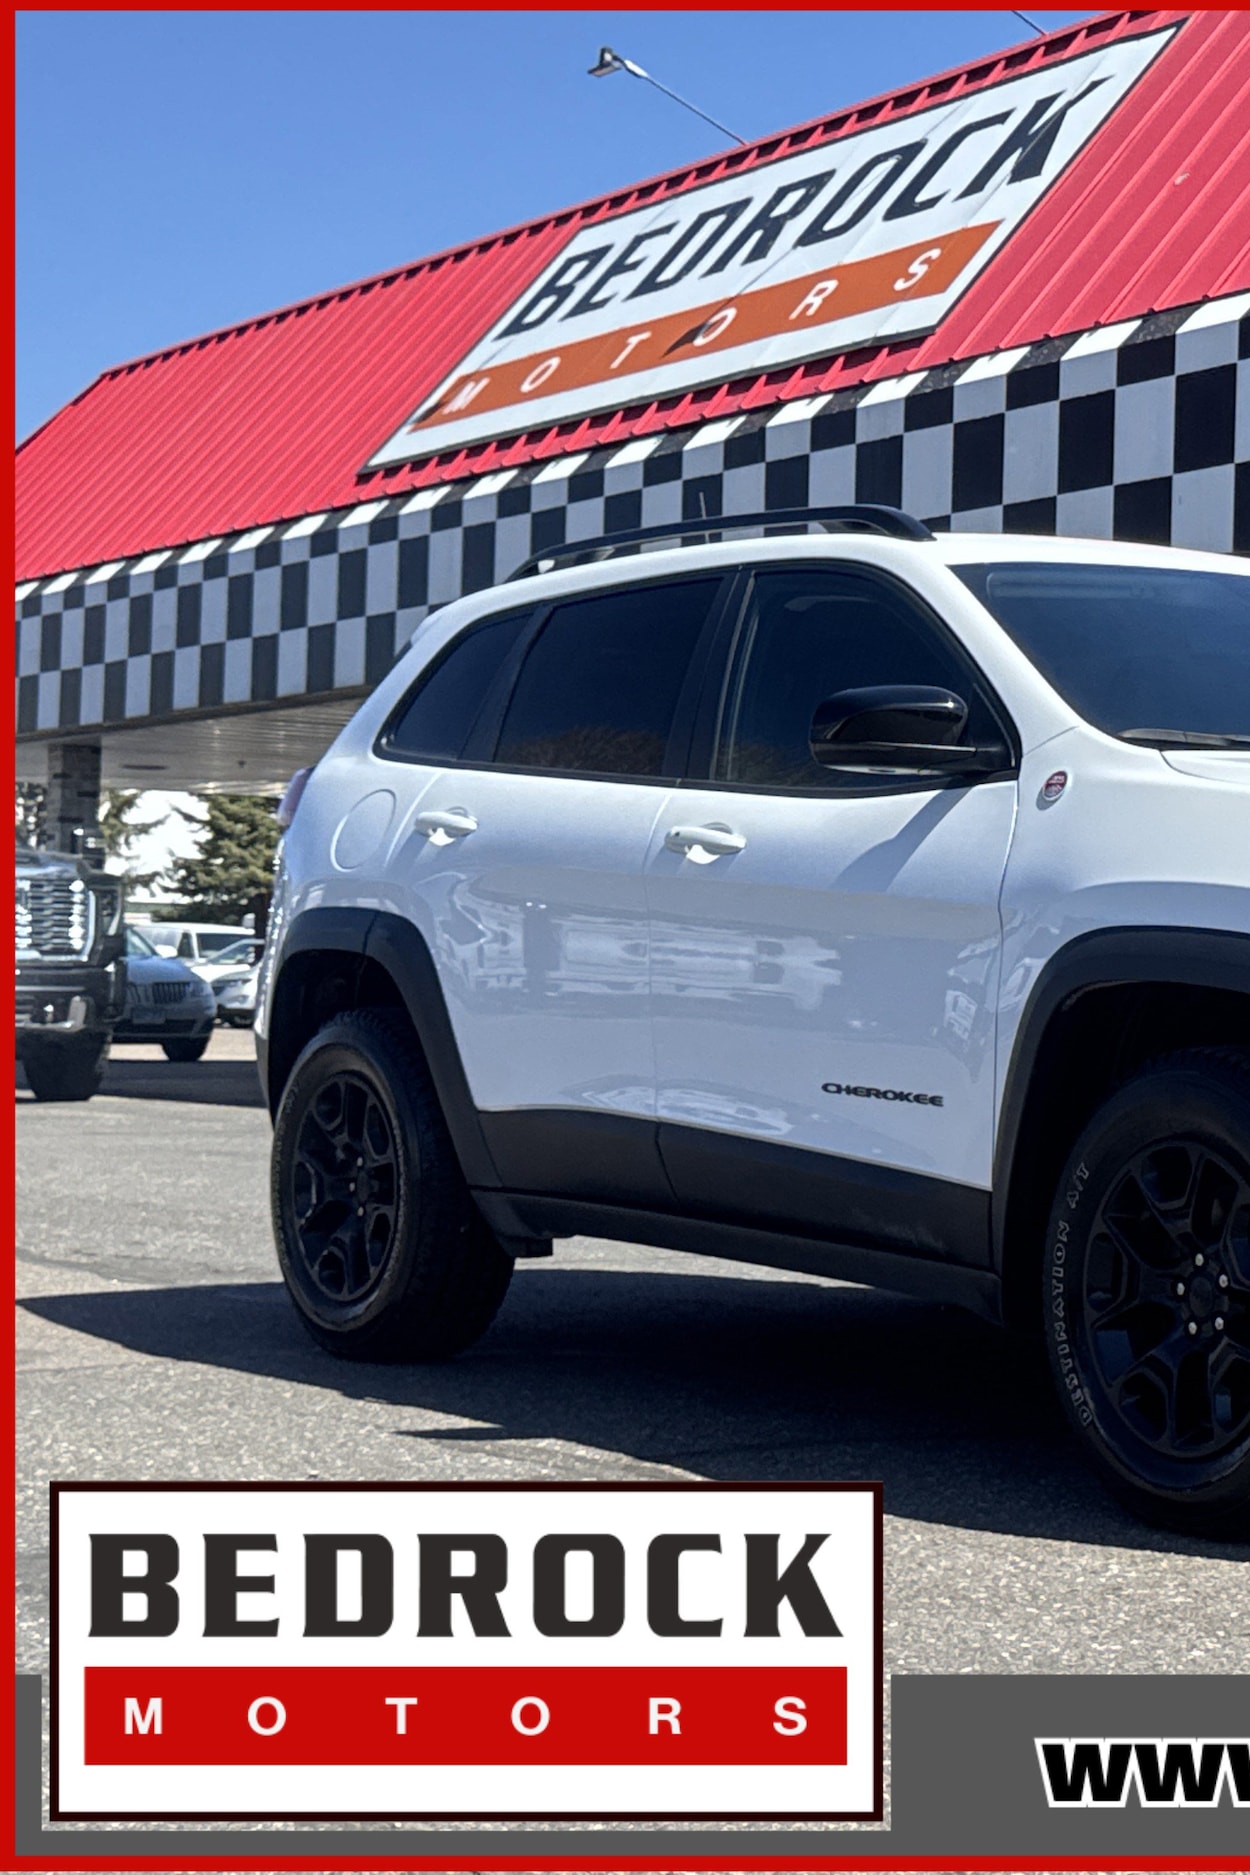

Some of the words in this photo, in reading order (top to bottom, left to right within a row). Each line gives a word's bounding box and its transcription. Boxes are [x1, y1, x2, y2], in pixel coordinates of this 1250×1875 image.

[496, 74, 1113, 342] BEDROCK
[442, 246, 942, 415] MOTORS
[821, 1082, 944, 1107] CHEROKEE
[1052, 1219, 1093, 1427] DESTINATION
